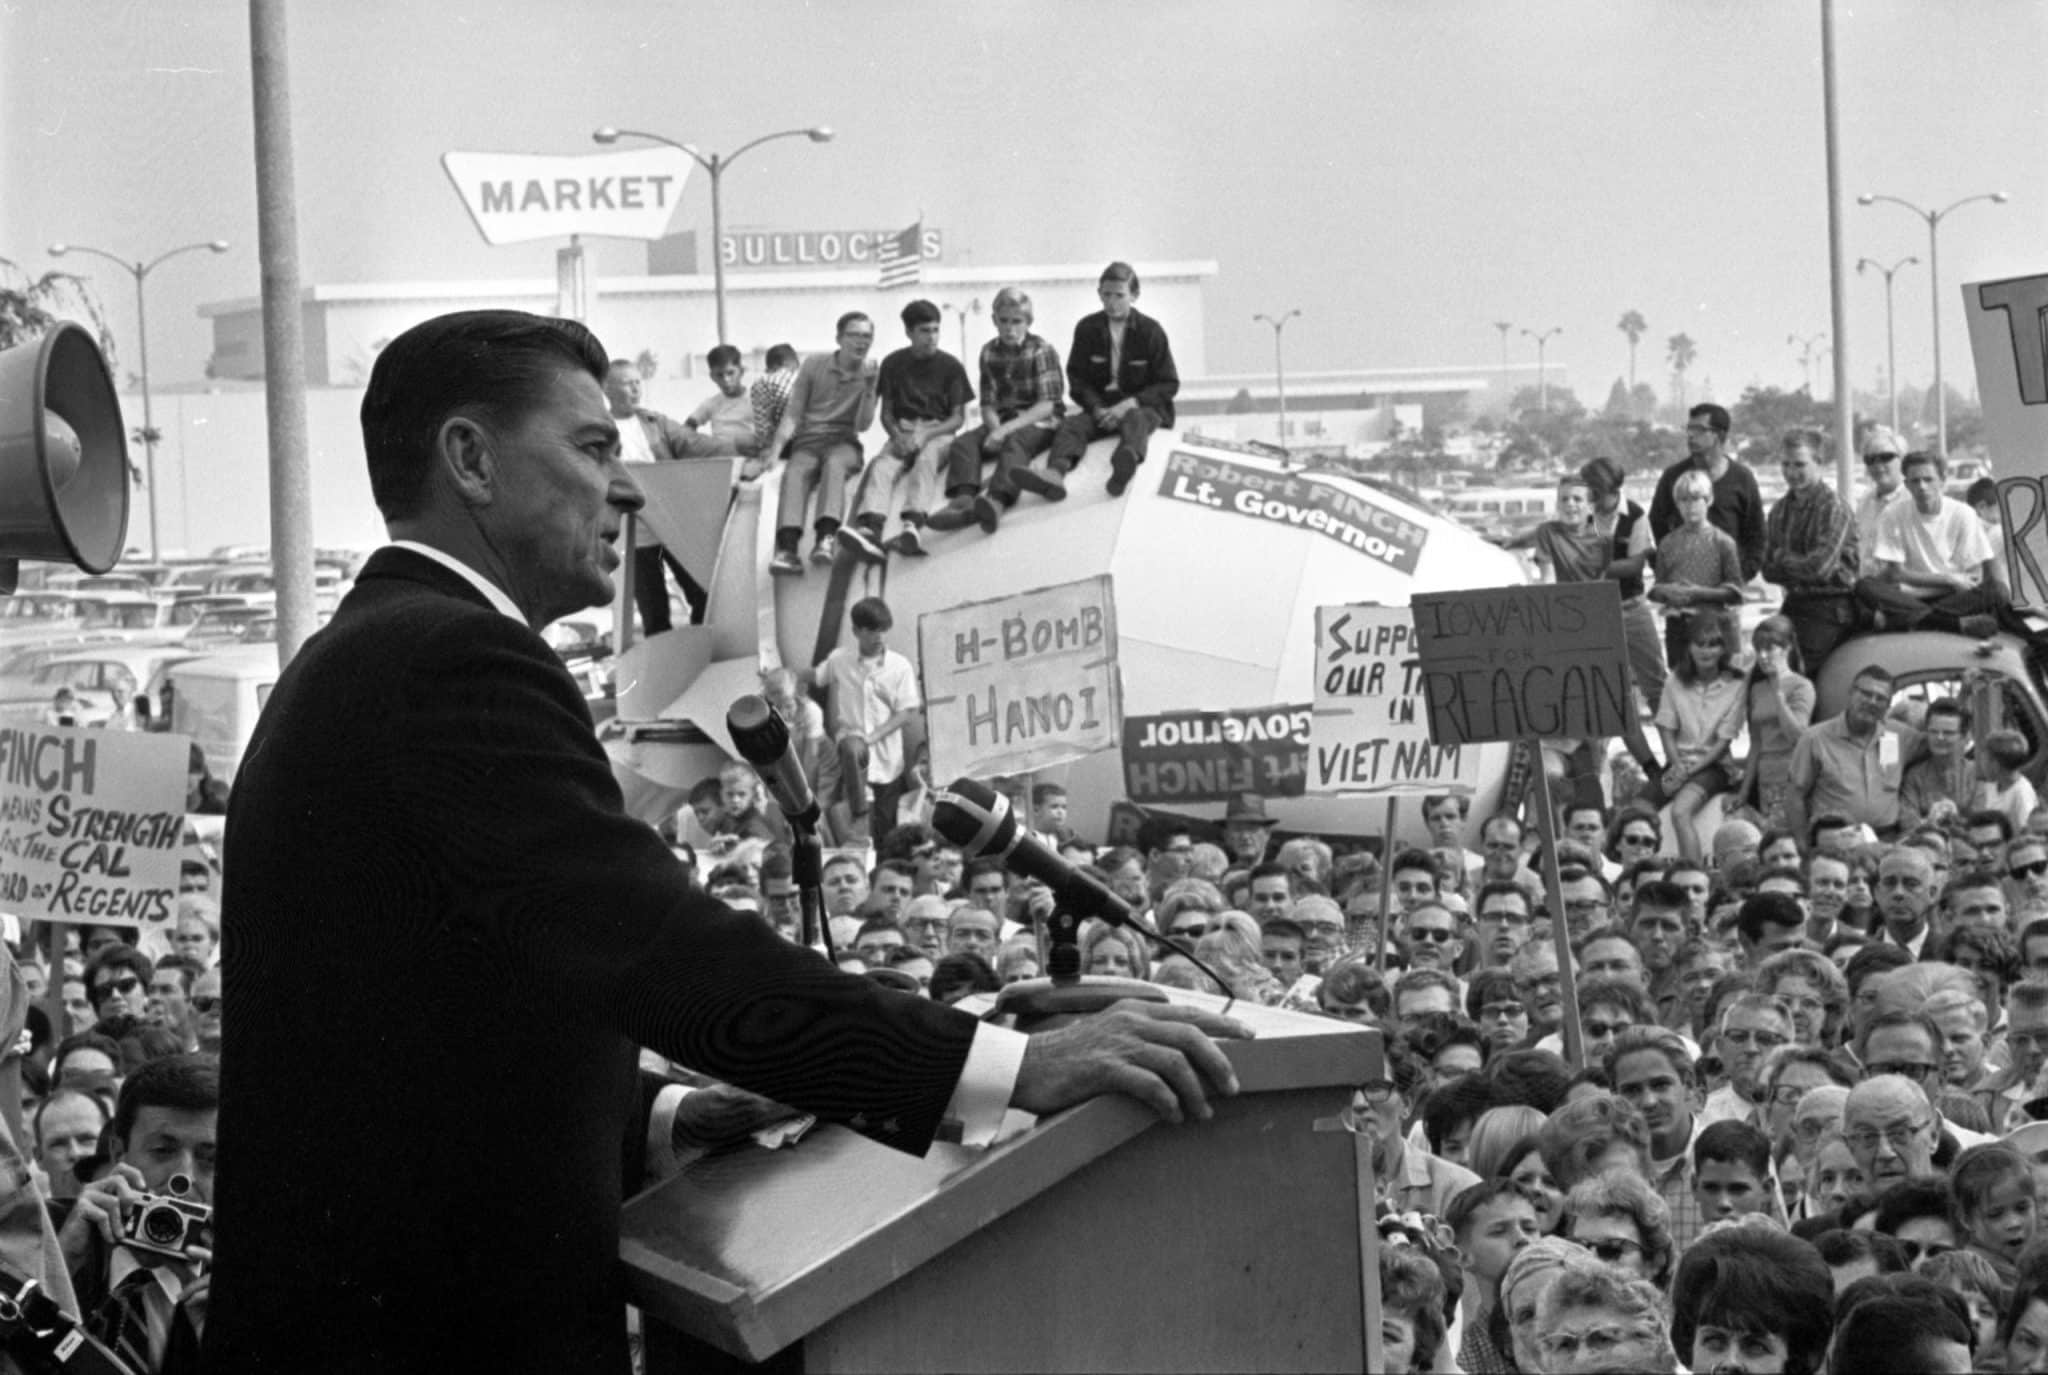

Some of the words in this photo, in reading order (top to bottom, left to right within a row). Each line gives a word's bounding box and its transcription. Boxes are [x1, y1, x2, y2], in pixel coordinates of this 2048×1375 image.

[481, 176, 673, 213] MARKET
[1978, 272, 2048, 405] T
[1168, 453, 1300, 497] Robert
[1307, 482, 1425, 547] FINCH
[1172, 475, 1224, 507] Lt.
[1233, 489, 1405, 563] Governor
[1996, 475, 2048, 608] R
[955, 606, 1103, 664] H-BOMB
[1423, 595, 1587, 639] IOWANS
[1324, 662, 1386, 694] OUR
[1424, 664, 1628, 745] REAGAN
[966, 684, 1100, 746] HANOI
[1138, 711, 1314, 748] Governor
[1388, 699, 1415, 724] IN
[0, 728, 97, 794] FINCH
[1128, 758, 1255, 796] FINCH
[46, 794, 184, 849] STRENGTH
[60, 841, 131, 877] CAL
[48, 871, 174, 922] REGENTS
